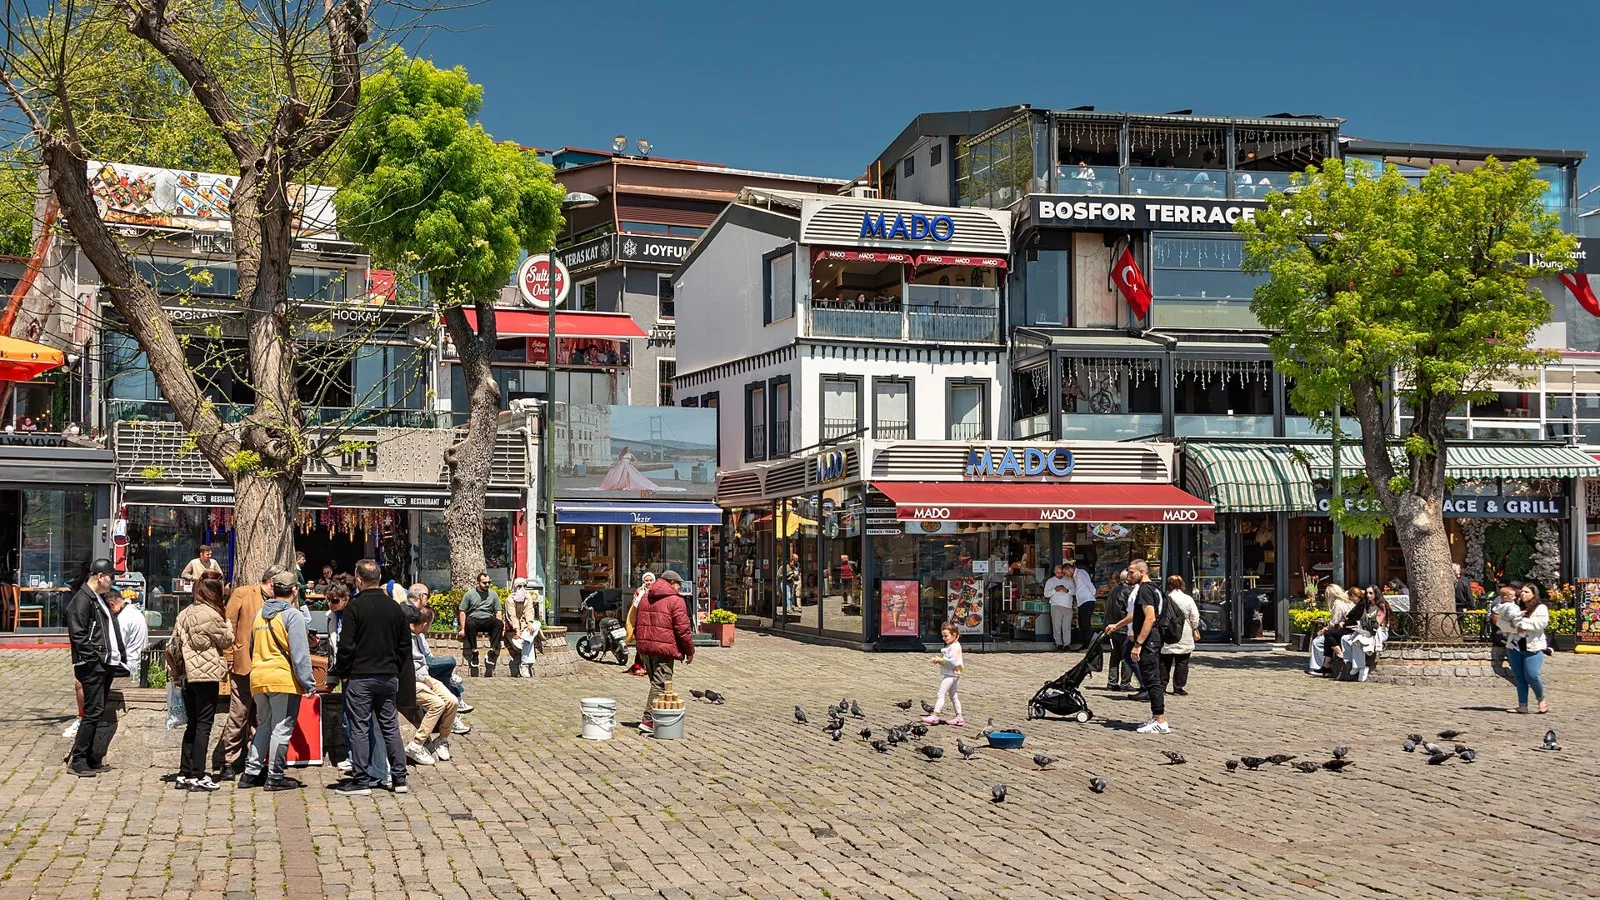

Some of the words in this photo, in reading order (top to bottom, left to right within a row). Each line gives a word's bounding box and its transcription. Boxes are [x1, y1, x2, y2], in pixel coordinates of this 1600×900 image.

[1039, 201, 1135, 221] BOSFOR
[1144, 203, 1255, 225] TERRACE
[860, 211, 955, 242] MADO
[565, 250, 585, 267] TERAS
[585, 246, 599, 261] KAT
[965, 445, 1075, 477] MADO
[210, 495, 236, 503] RESTAURA
[410, 497, 440, 506] RESTAURANT
[1486, 501, 1498, 513] &
[1506, 501, 1559, 513] GRILL
[630, 512, 652, 523] Vezir
[913, 508, 950, 518] MADO
[1040, 509, 1076, 520] MADO
[1162, 510, 1198, 521] MADO
